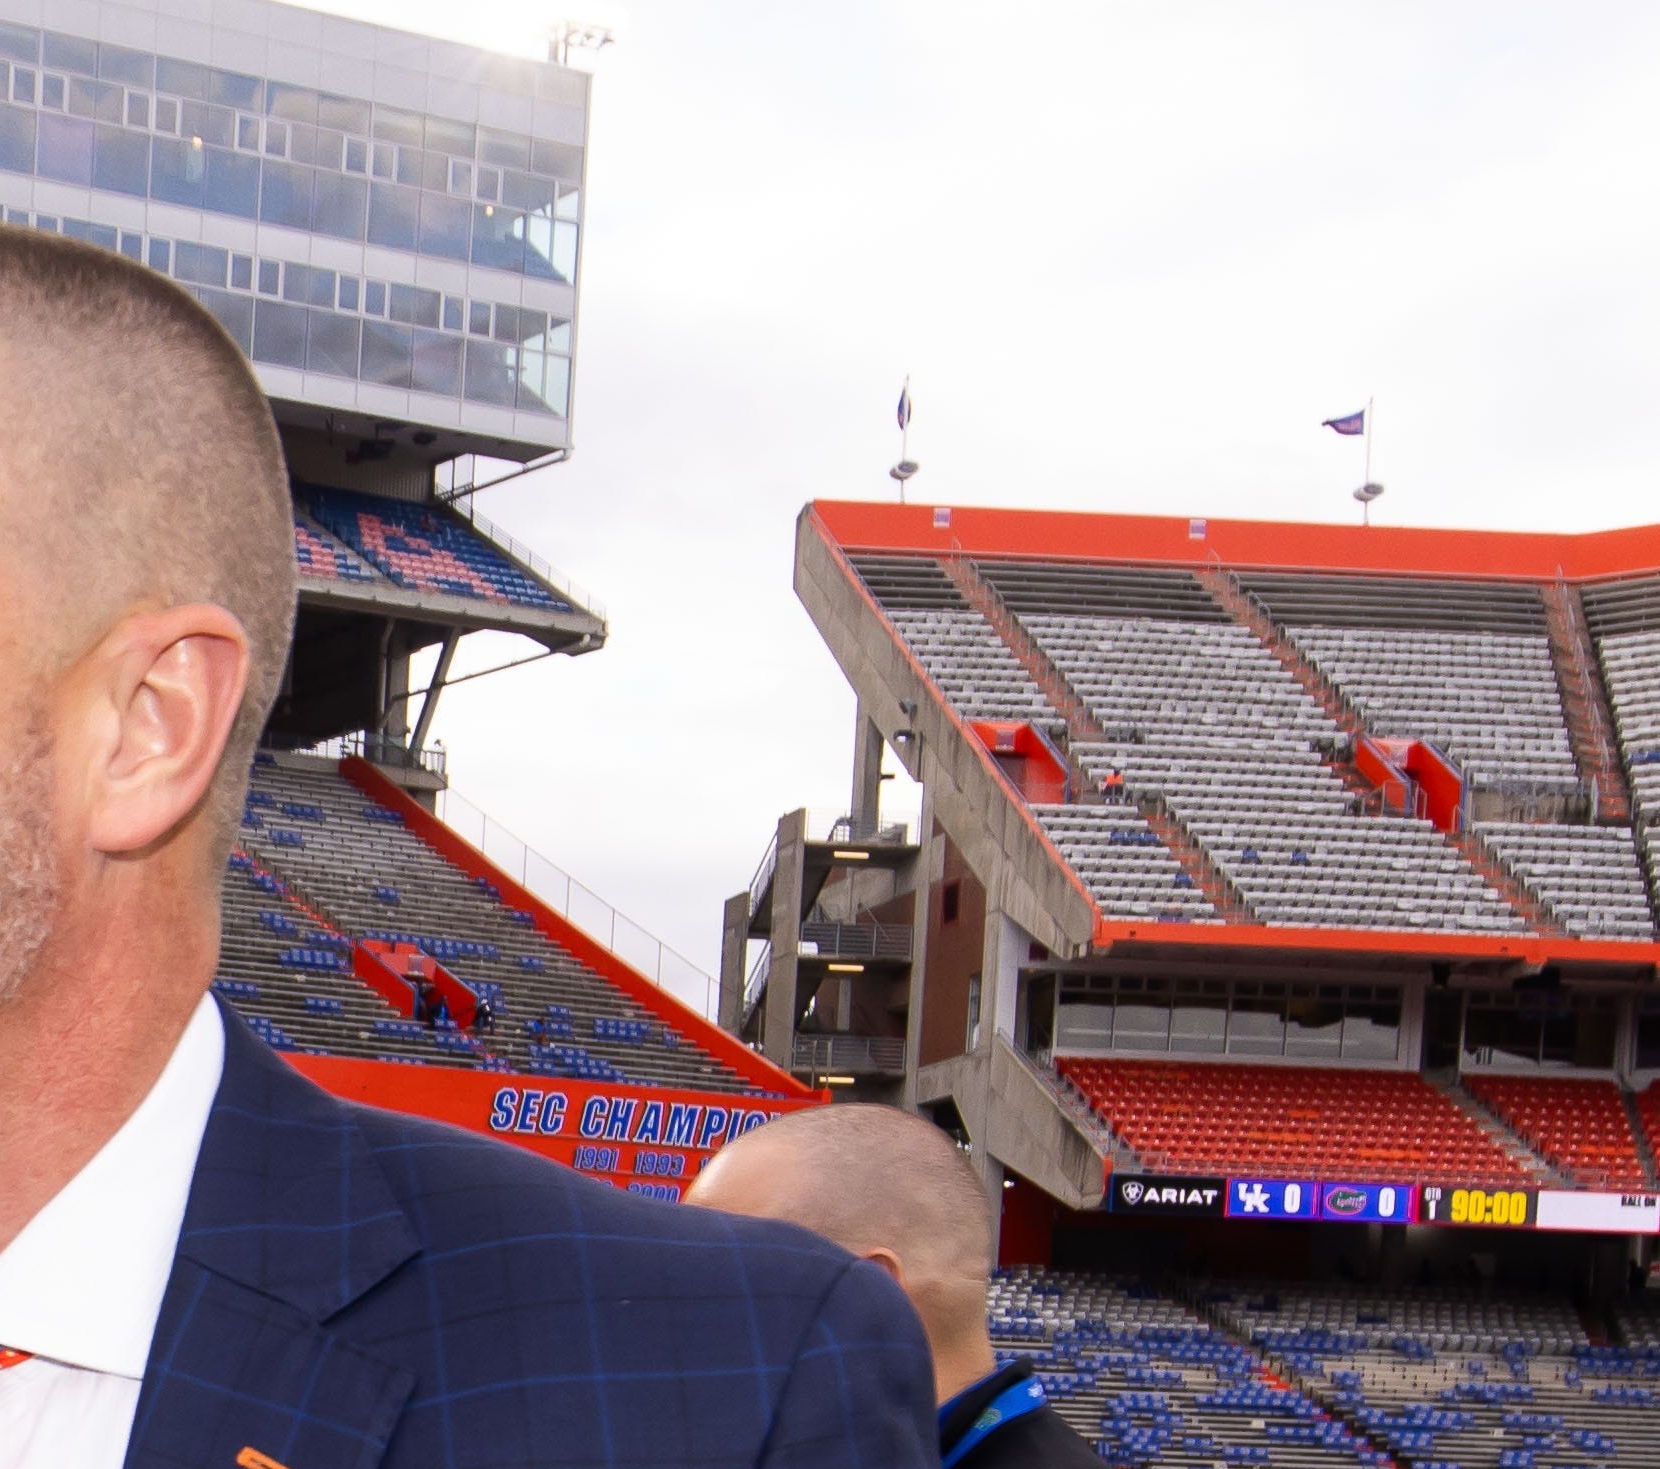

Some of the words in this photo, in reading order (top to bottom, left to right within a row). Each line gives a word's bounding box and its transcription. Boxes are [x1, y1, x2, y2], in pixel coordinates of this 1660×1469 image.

[490, 1086, 569, 1135] SEC
[579, 1094, 783, 1149] CHAMPI
[574, 1145, 619, 1172] 1991
[635, 1150, 685, 1177] 1993
[1144, 1187, 1218, 1206] ARIAT
[1284, 1183, 1301, 1214] 0
[1378, 1187, 1395, 1217] 0
[1451, 1189, 1527, 1224] 90:00
